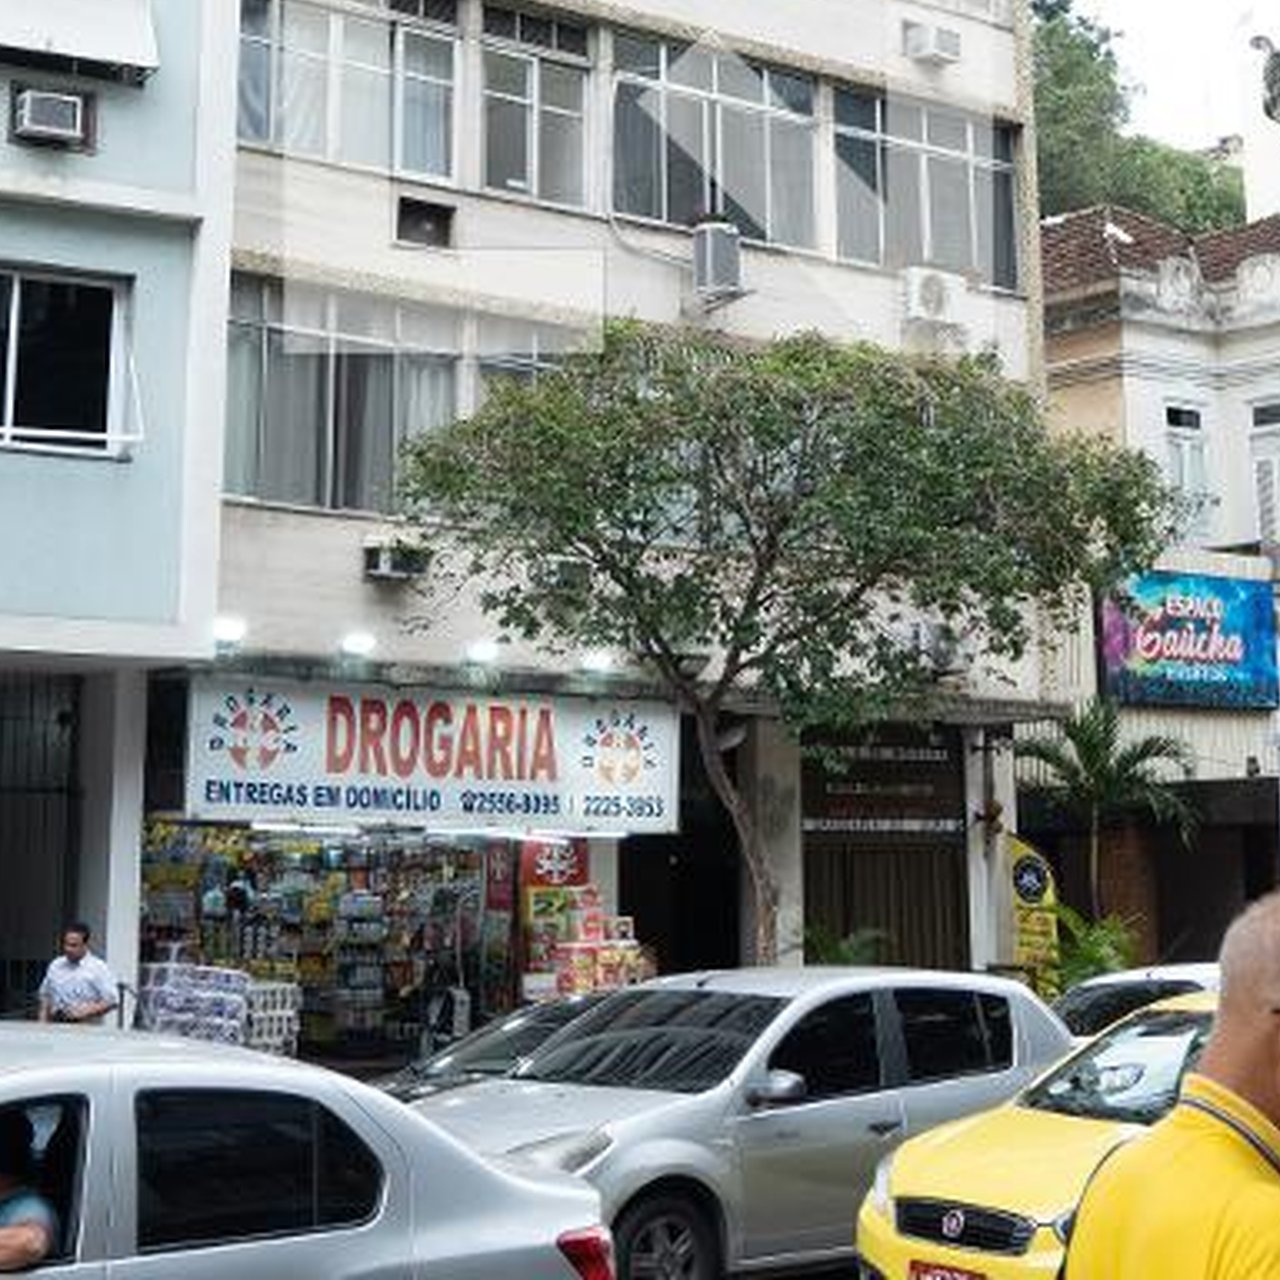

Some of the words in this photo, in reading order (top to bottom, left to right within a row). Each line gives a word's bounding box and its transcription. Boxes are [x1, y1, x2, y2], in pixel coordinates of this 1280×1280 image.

[324, 693, 559, 781] DROGARIA
[205, 779, 308, 808] ENTREGAS
[313, 784, 343, 808] EM
